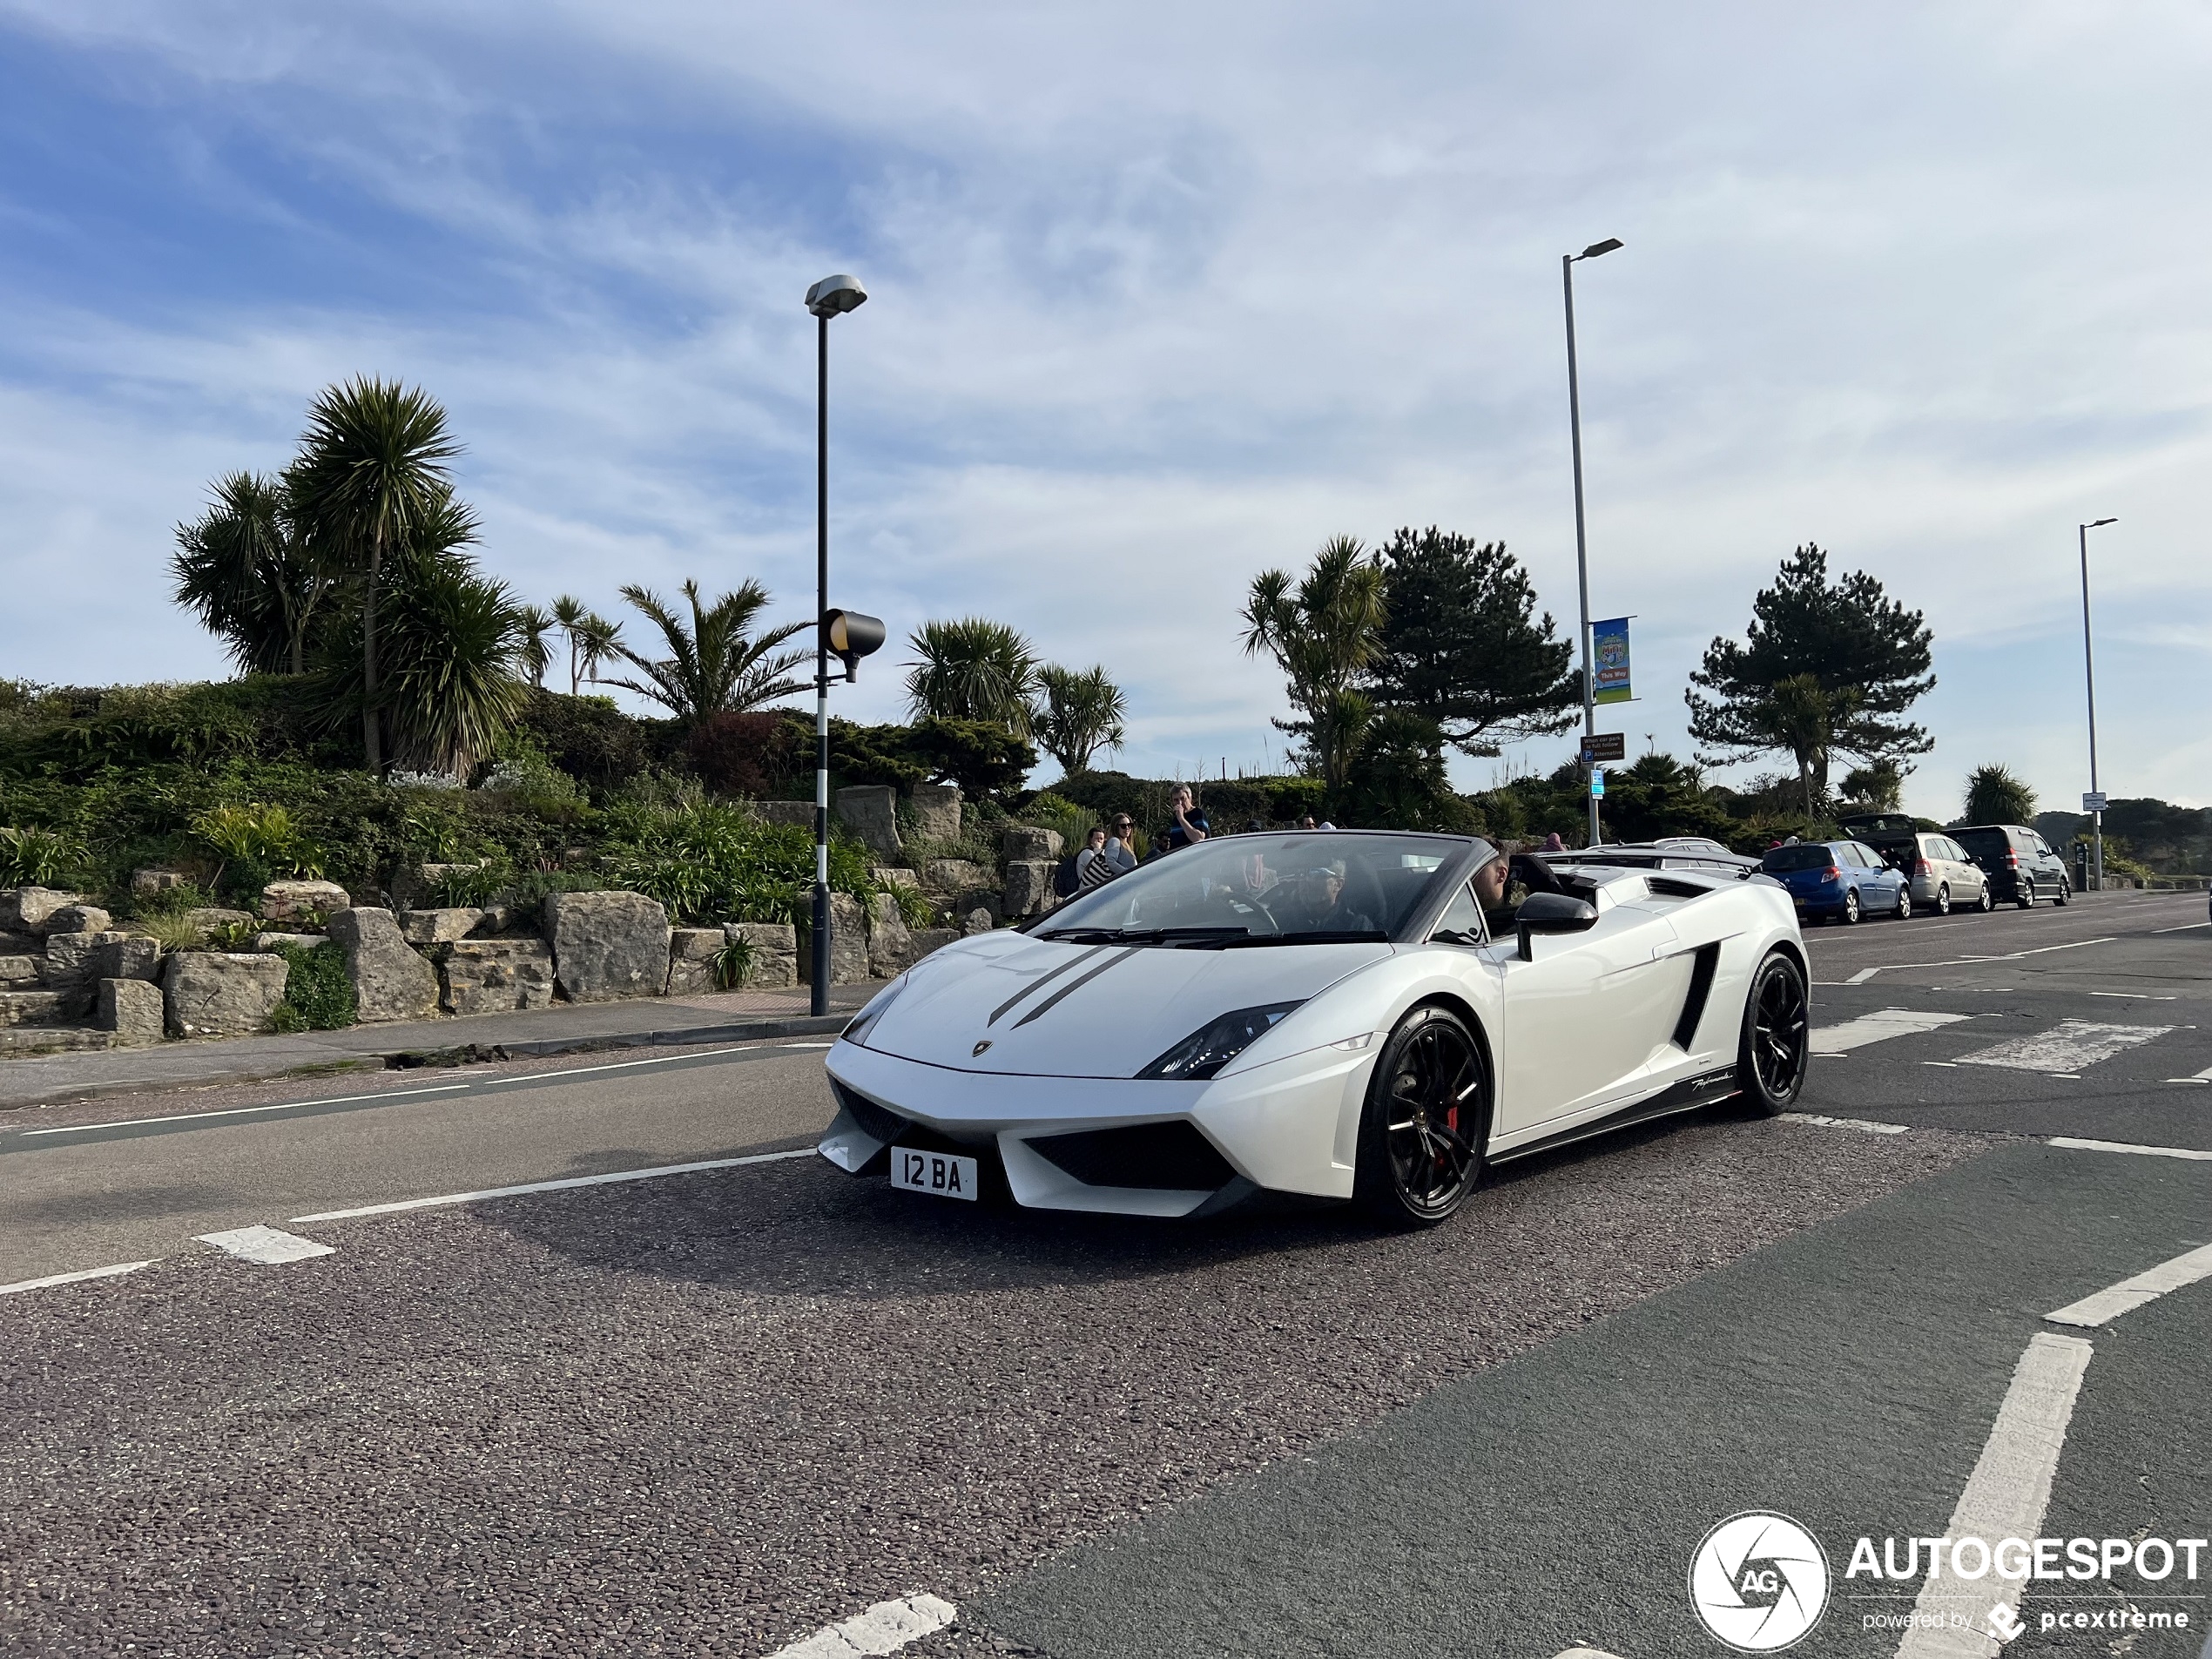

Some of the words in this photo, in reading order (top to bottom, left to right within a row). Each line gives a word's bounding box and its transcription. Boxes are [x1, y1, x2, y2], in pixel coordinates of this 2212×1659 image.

[1585, 751, 1591, 760] P
[905, 1154, 924, 1185] 12
[932, 1158, 961, 1192] BA
